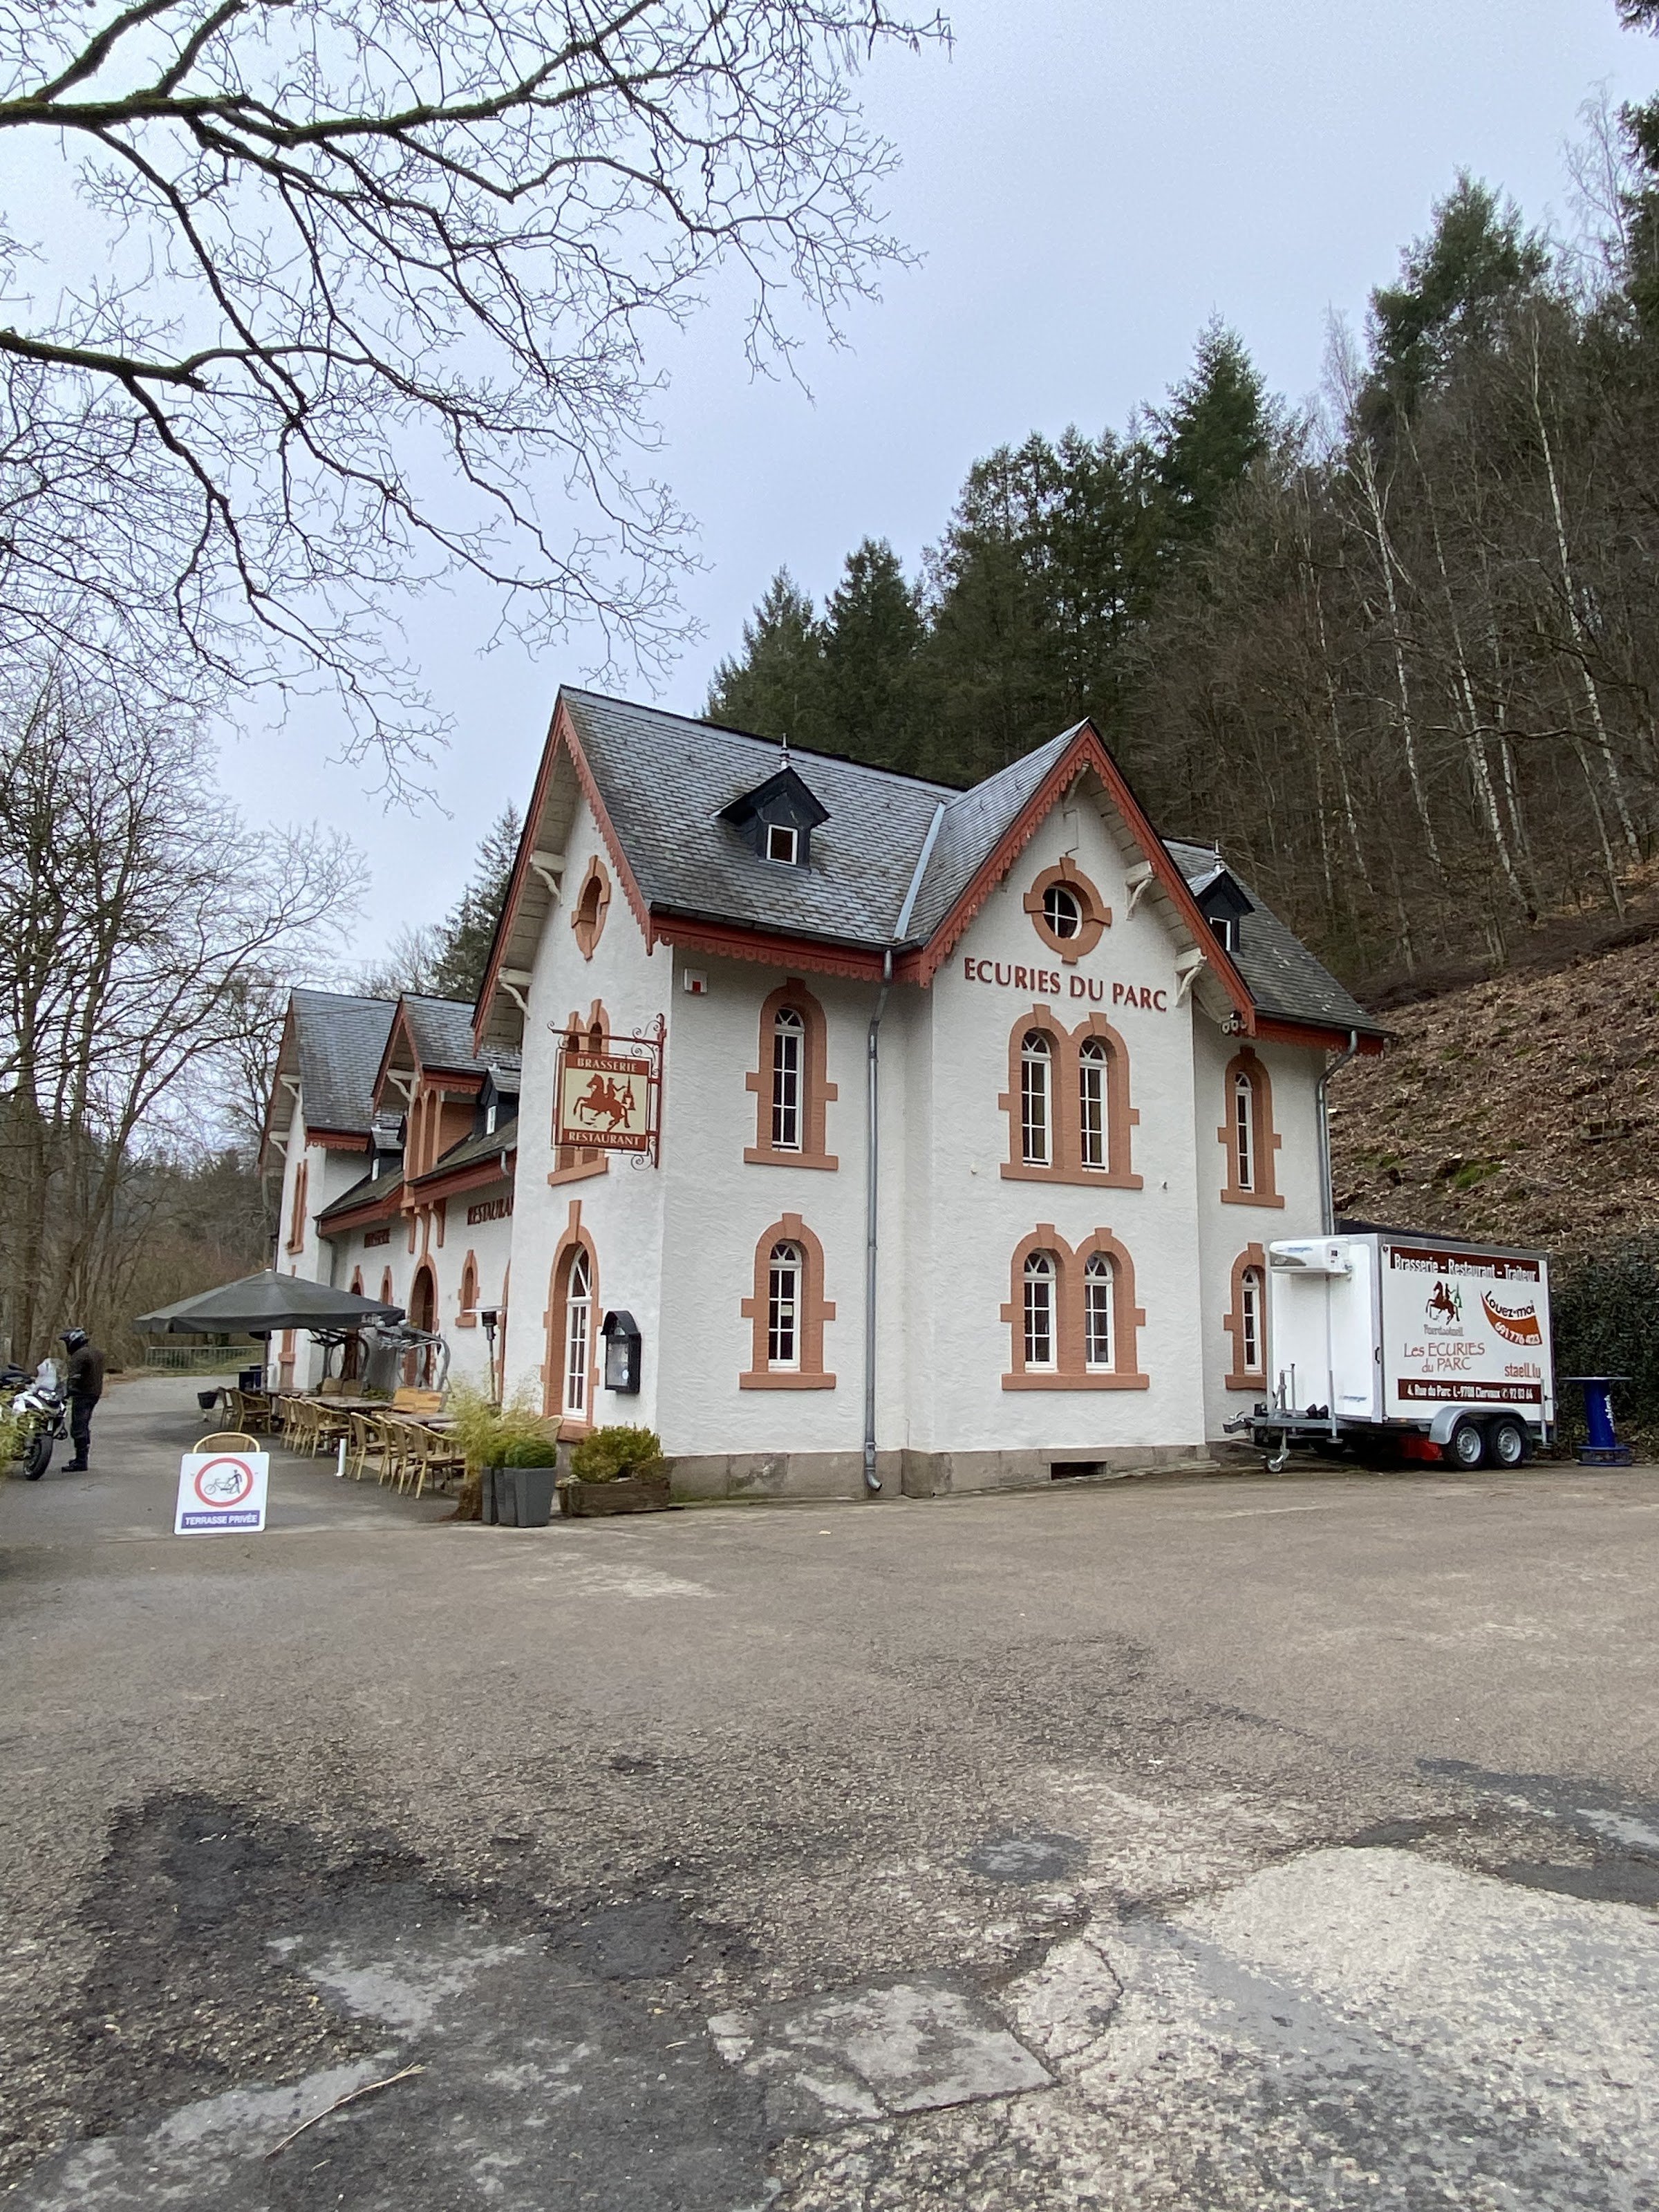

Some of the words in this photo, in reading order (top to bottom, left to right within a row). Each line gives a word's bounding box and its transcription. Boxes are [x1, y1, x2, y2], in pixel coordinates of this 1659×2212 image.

[964, 957, 1061, 994] ECURIES
[1070, 975, 1103, 1001] DU
[1112, 982, 1167, 1011] PARC
[577, 1058, 637, 1071] BRASSERIE
[568, 1132, 640, 1146] RESTAURANT
[1394, 1253, 1438, 1273] Brasserie
[1448, 1259, 1495, 1278] Restaurant
[1485, 1291, 1535, 1318] Louez-moi
[1404, 1342, 1424, 1358] Les
[1428, 1342, 1485, 1356] ECURIES
[1421, 1358, 1434, 1373] du
[1437, 1357, 1472, 1371] PARC
[185, 1515, 227, 1525] TERRASSE
[228, 1512, 258, 1524] PRIVÉE
